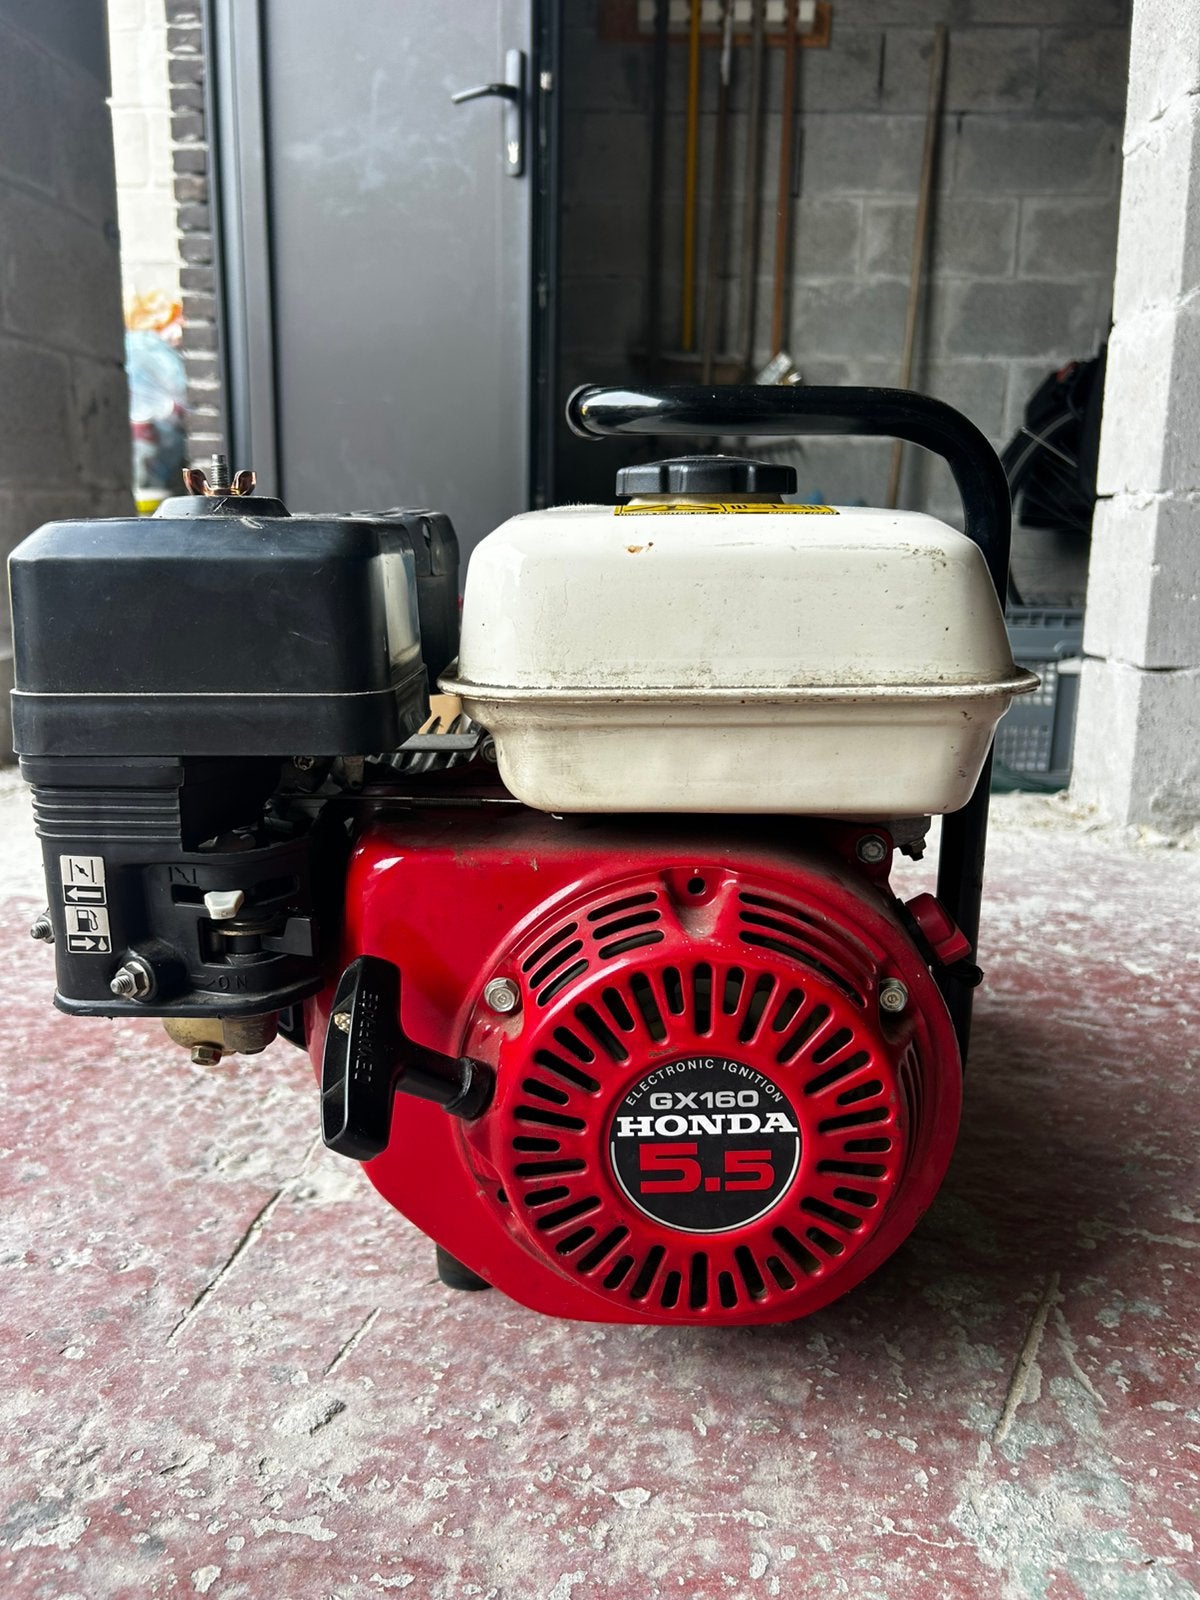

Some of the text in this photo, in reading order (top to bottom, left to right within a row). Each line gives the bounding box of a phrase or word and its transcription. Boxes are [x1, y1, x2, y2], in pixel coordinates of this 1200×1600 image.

[625, 1058, 783, 1106] ELECTRONIC IGNITION
[649, 1089, 759, 1110] GX160
[616, 1112, 798, 1137] HONDA
[639, 1142, 775, 1193] 5.5
